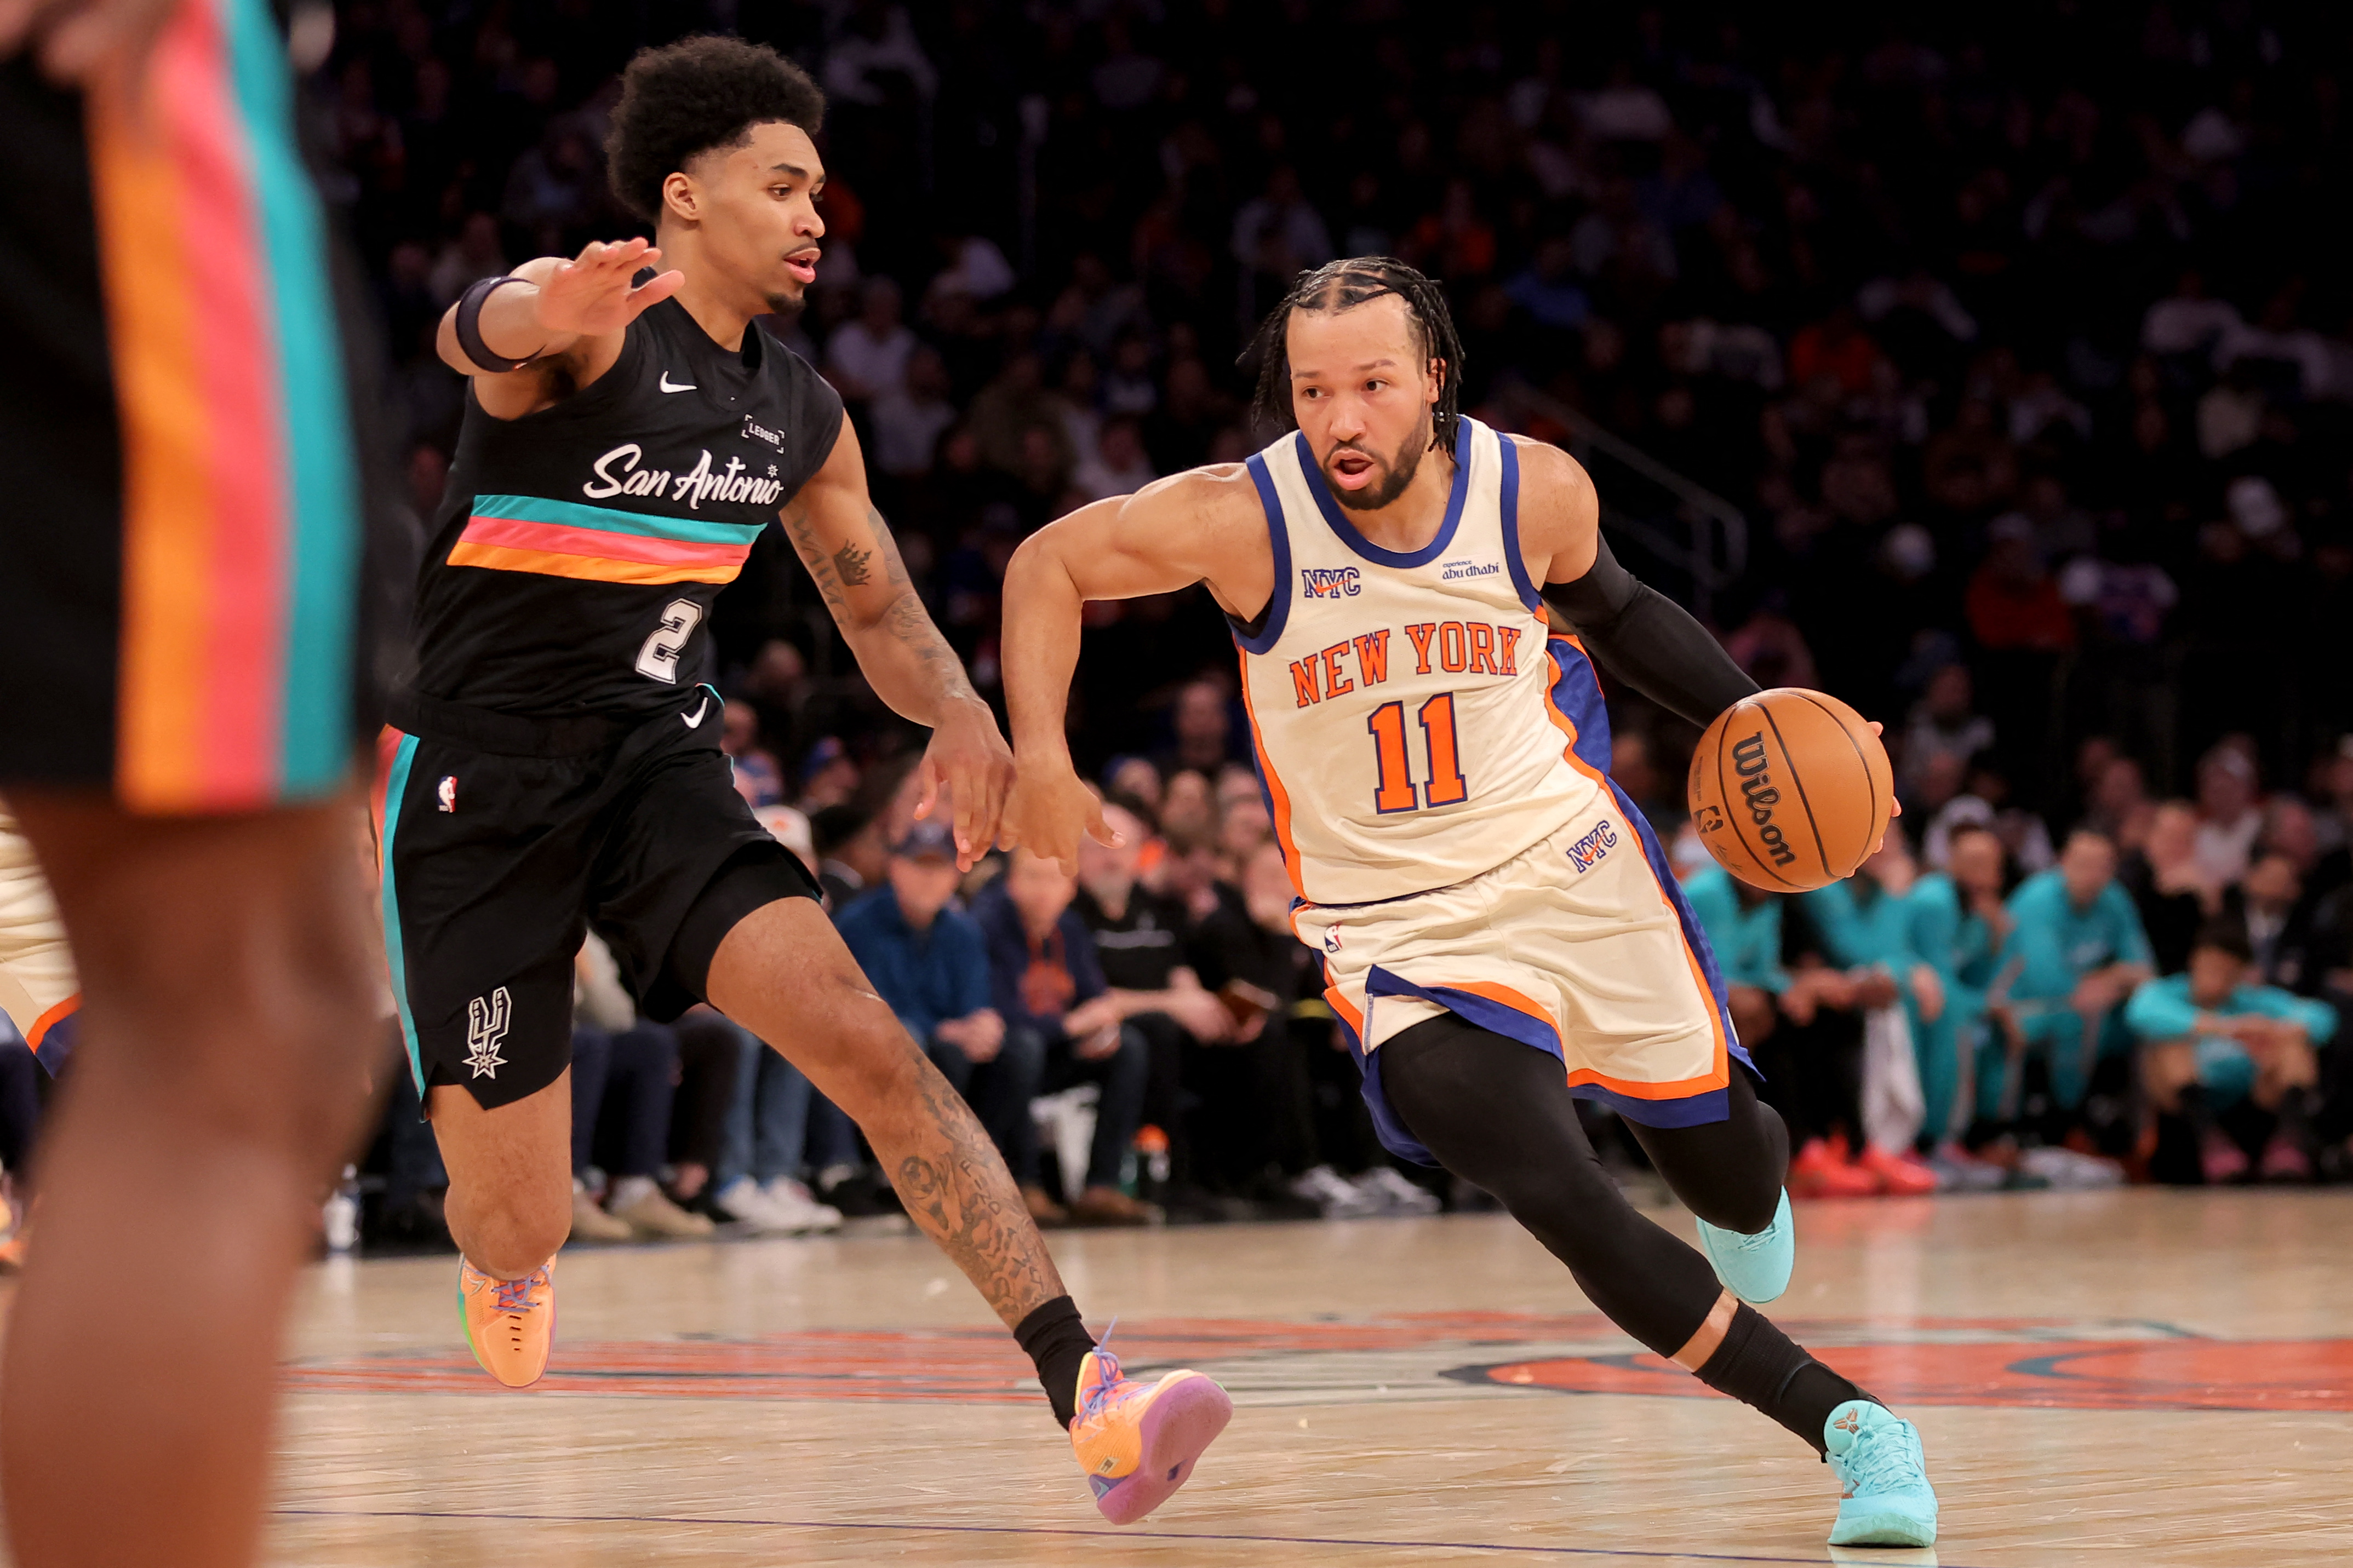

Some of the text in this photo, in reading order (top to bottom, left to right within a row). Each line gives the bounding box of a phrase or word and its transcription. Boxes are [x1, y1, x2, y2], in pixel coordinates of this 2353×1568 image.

[748, 422, 780, 446] LEDGER
[582, 443, 785, 510] San Antonio
[1301, 567, 1361, 599] NYC
[1442, 560, 1472, 568] experience
[1442, 568, 1464, 579] abu
[634, 598, 703, 685] 2
[1290, 621, 1521, 708] NEW YORK
[1367, 692, 1468, 815] 11
[1731, 731, 1797, 868] Wilson
[1566, 820, 1618, 874] NYC
